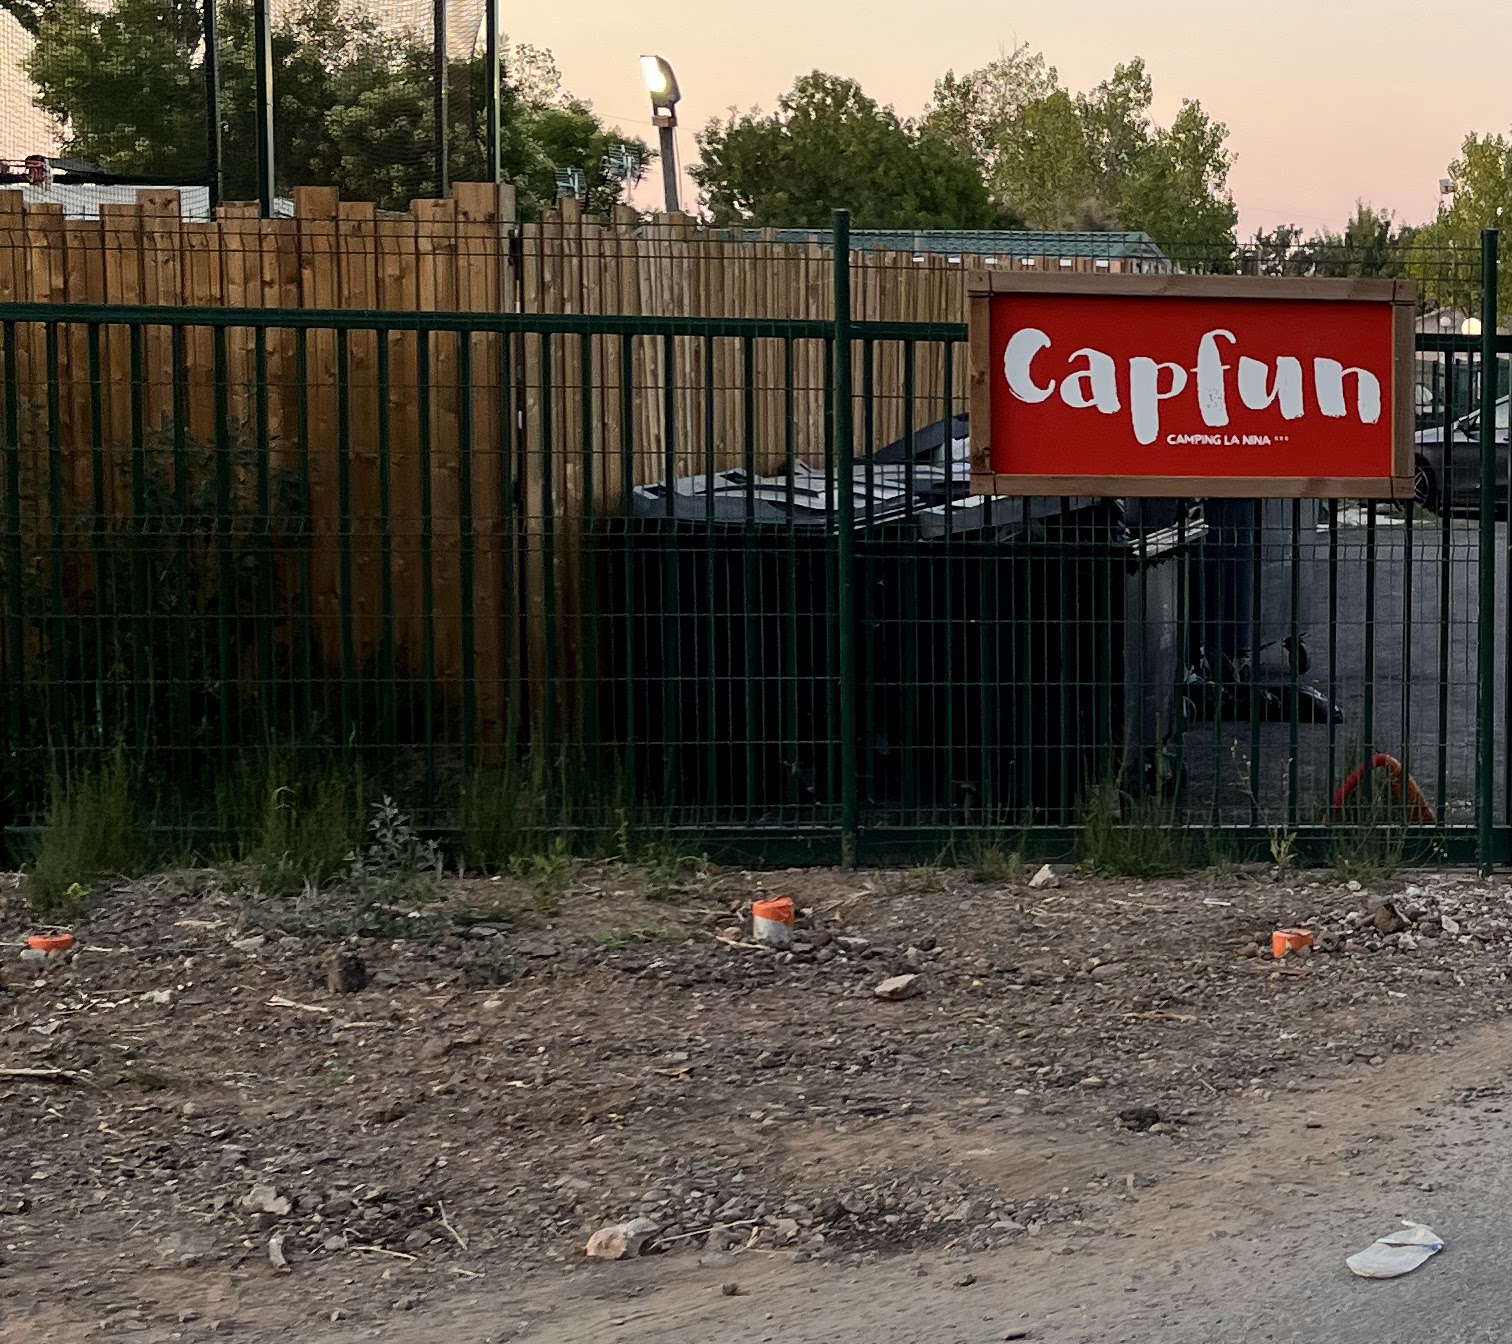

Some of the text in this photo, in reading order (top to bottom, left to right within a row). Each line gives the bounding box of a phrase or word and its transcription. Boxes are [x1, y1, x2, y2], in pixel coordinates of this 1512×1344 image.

[1003, 327, 1381, 445] Capfun
[1166, 433, 1271, 446] CAMPING LA NINA
